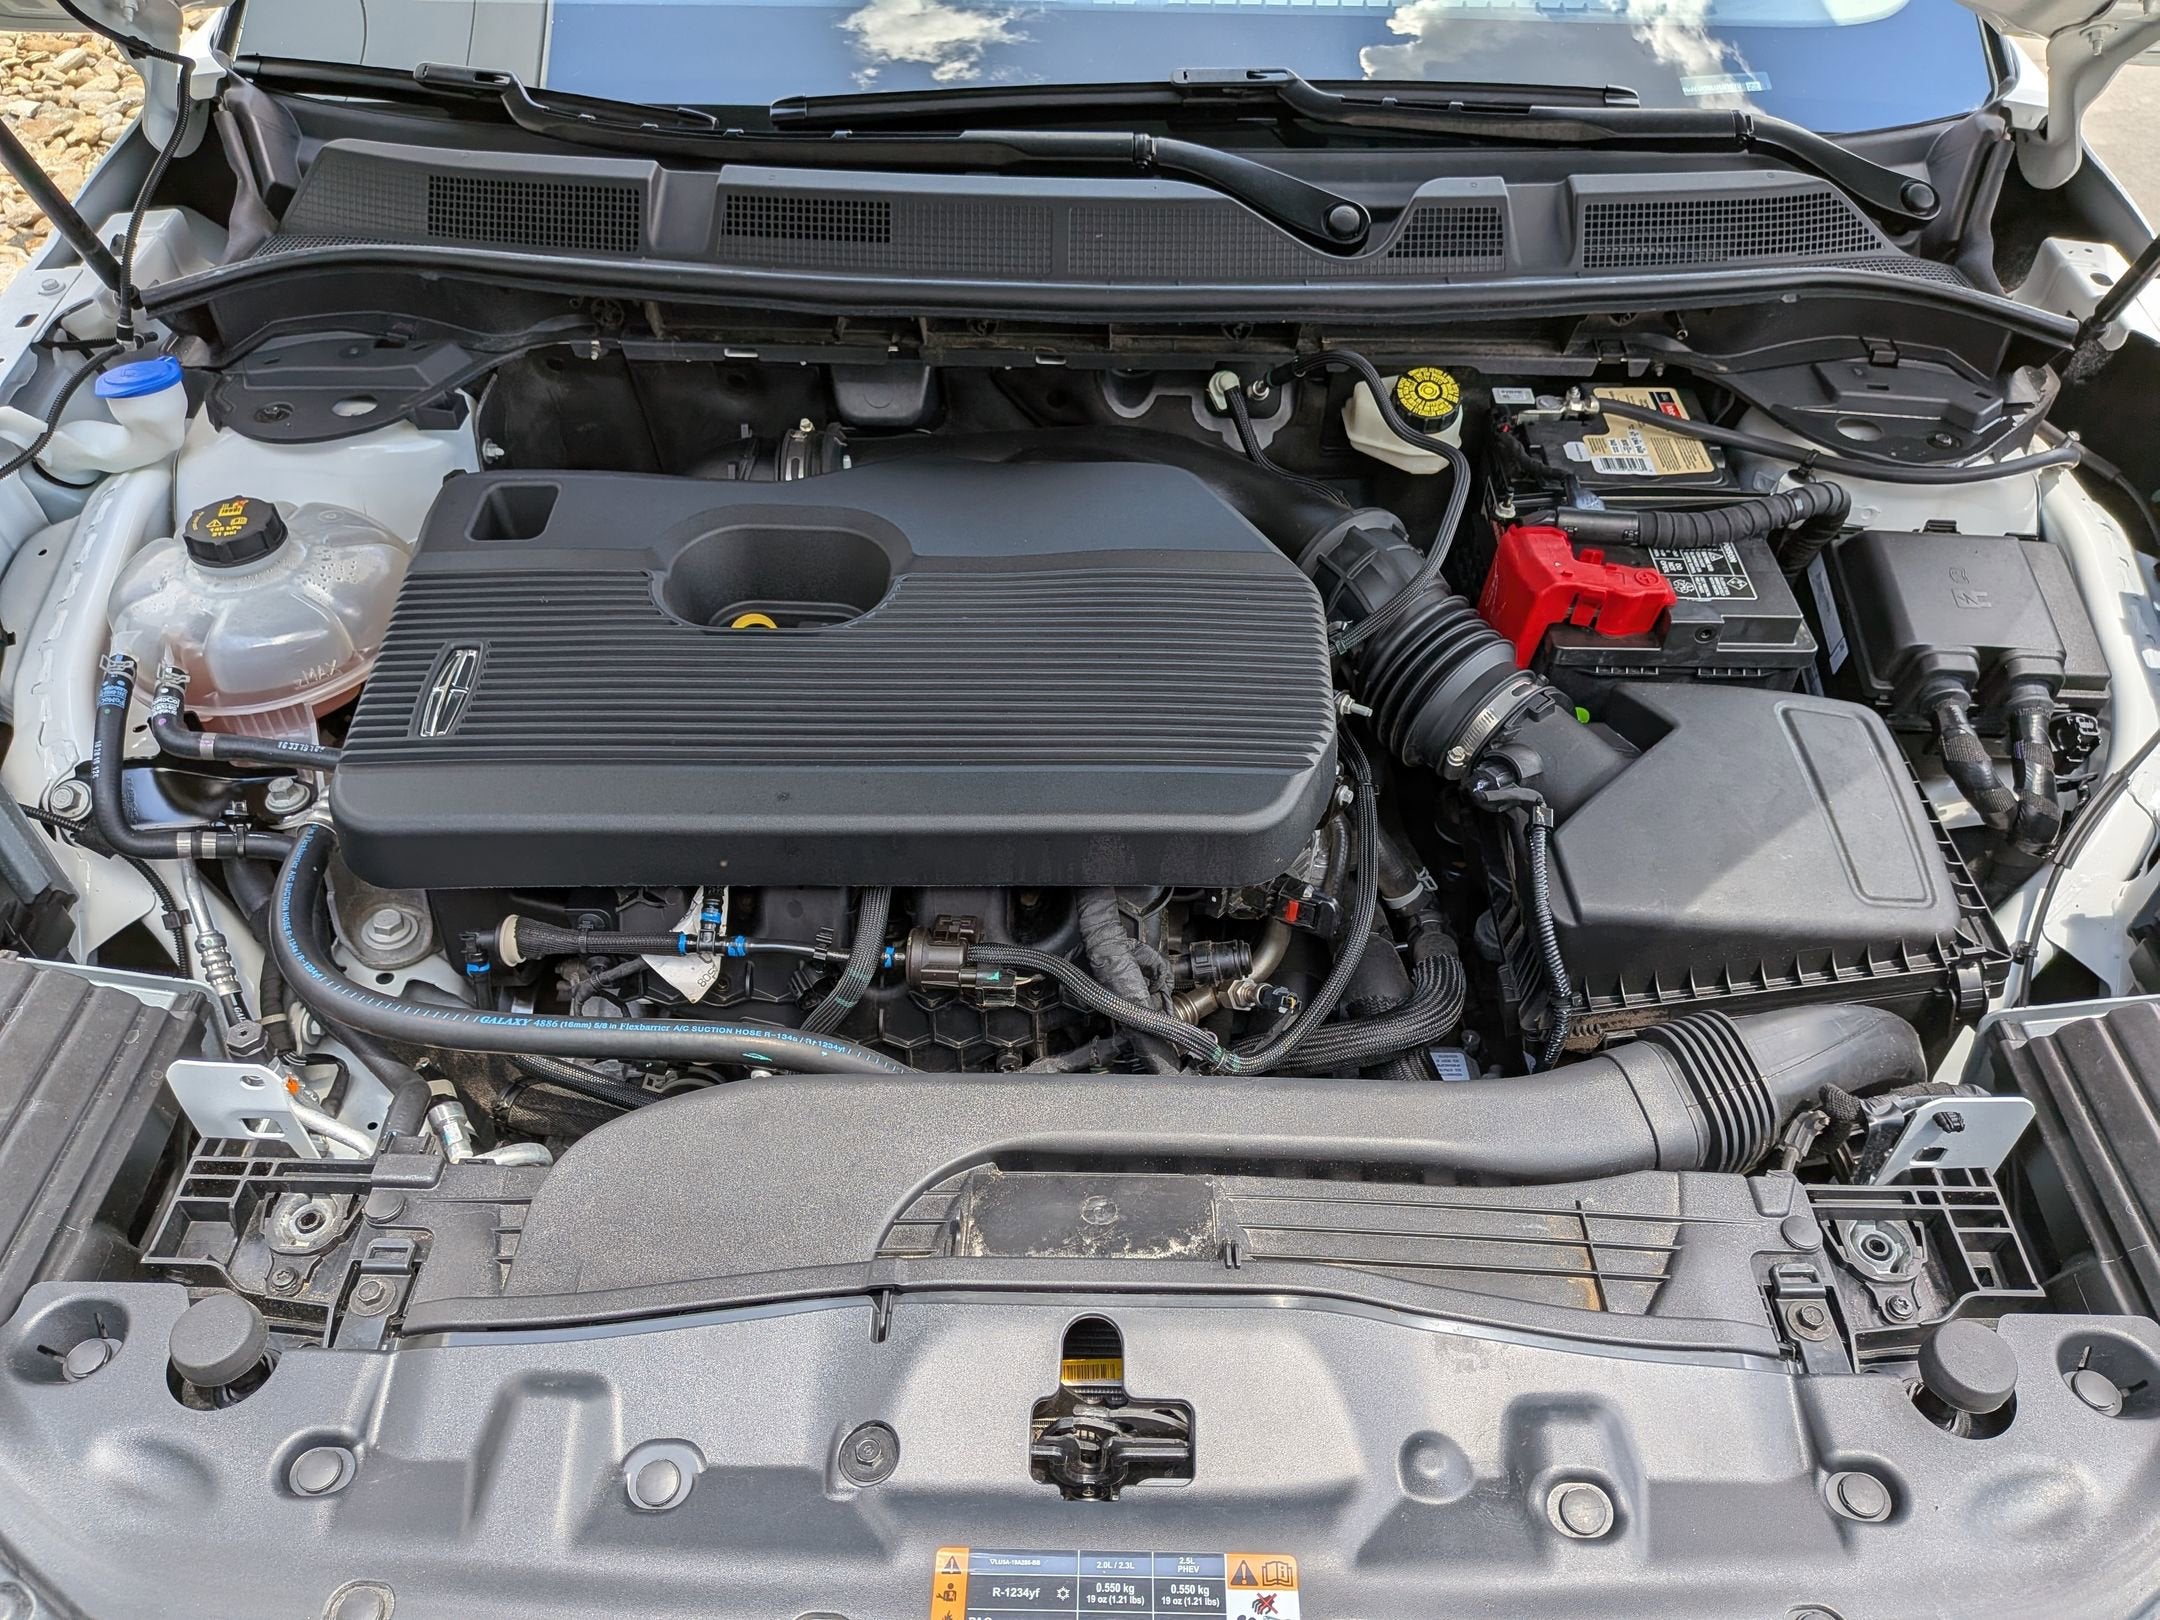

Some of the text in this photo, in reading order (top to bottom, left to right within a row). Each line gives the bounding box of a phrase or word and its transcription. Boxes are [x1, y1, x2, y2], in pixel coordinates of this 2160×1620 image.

[480, 1015, 532, 1027] GALAXY
[533, 1020, 558, 1028] 4886
[559, 1021, 593, 1030] (16mm)
[619, 1023, 671, 1032] Flexbarrier
[673, 1025, 690, 1033] A/C
[691, 1025, 734, 1035] SUCTION
[735, 1028, 762, 1038] HOSE
[1096, 1561, 1113, 1569] 2.0L
[1177, 1565, 1200, 1573] PHEV
[992, 1587, 1041, 1600] R-1234yf
[1096, 1582, 1135, 1595] 0.550 kg
[1171, 1584, 1210, 1597] 0.550 kg
[1086, 1595, 1096, 1603] 19
[1108, 1595, 1128, 1606] (1.21
[1129, 1595, 1145, 1606] lbs)
[1161, 1596, 1171, 1605] 19
[1184, 1597, 1203, 1608] (1.21
[1204, 1597, 1220, 1608] lbs)
